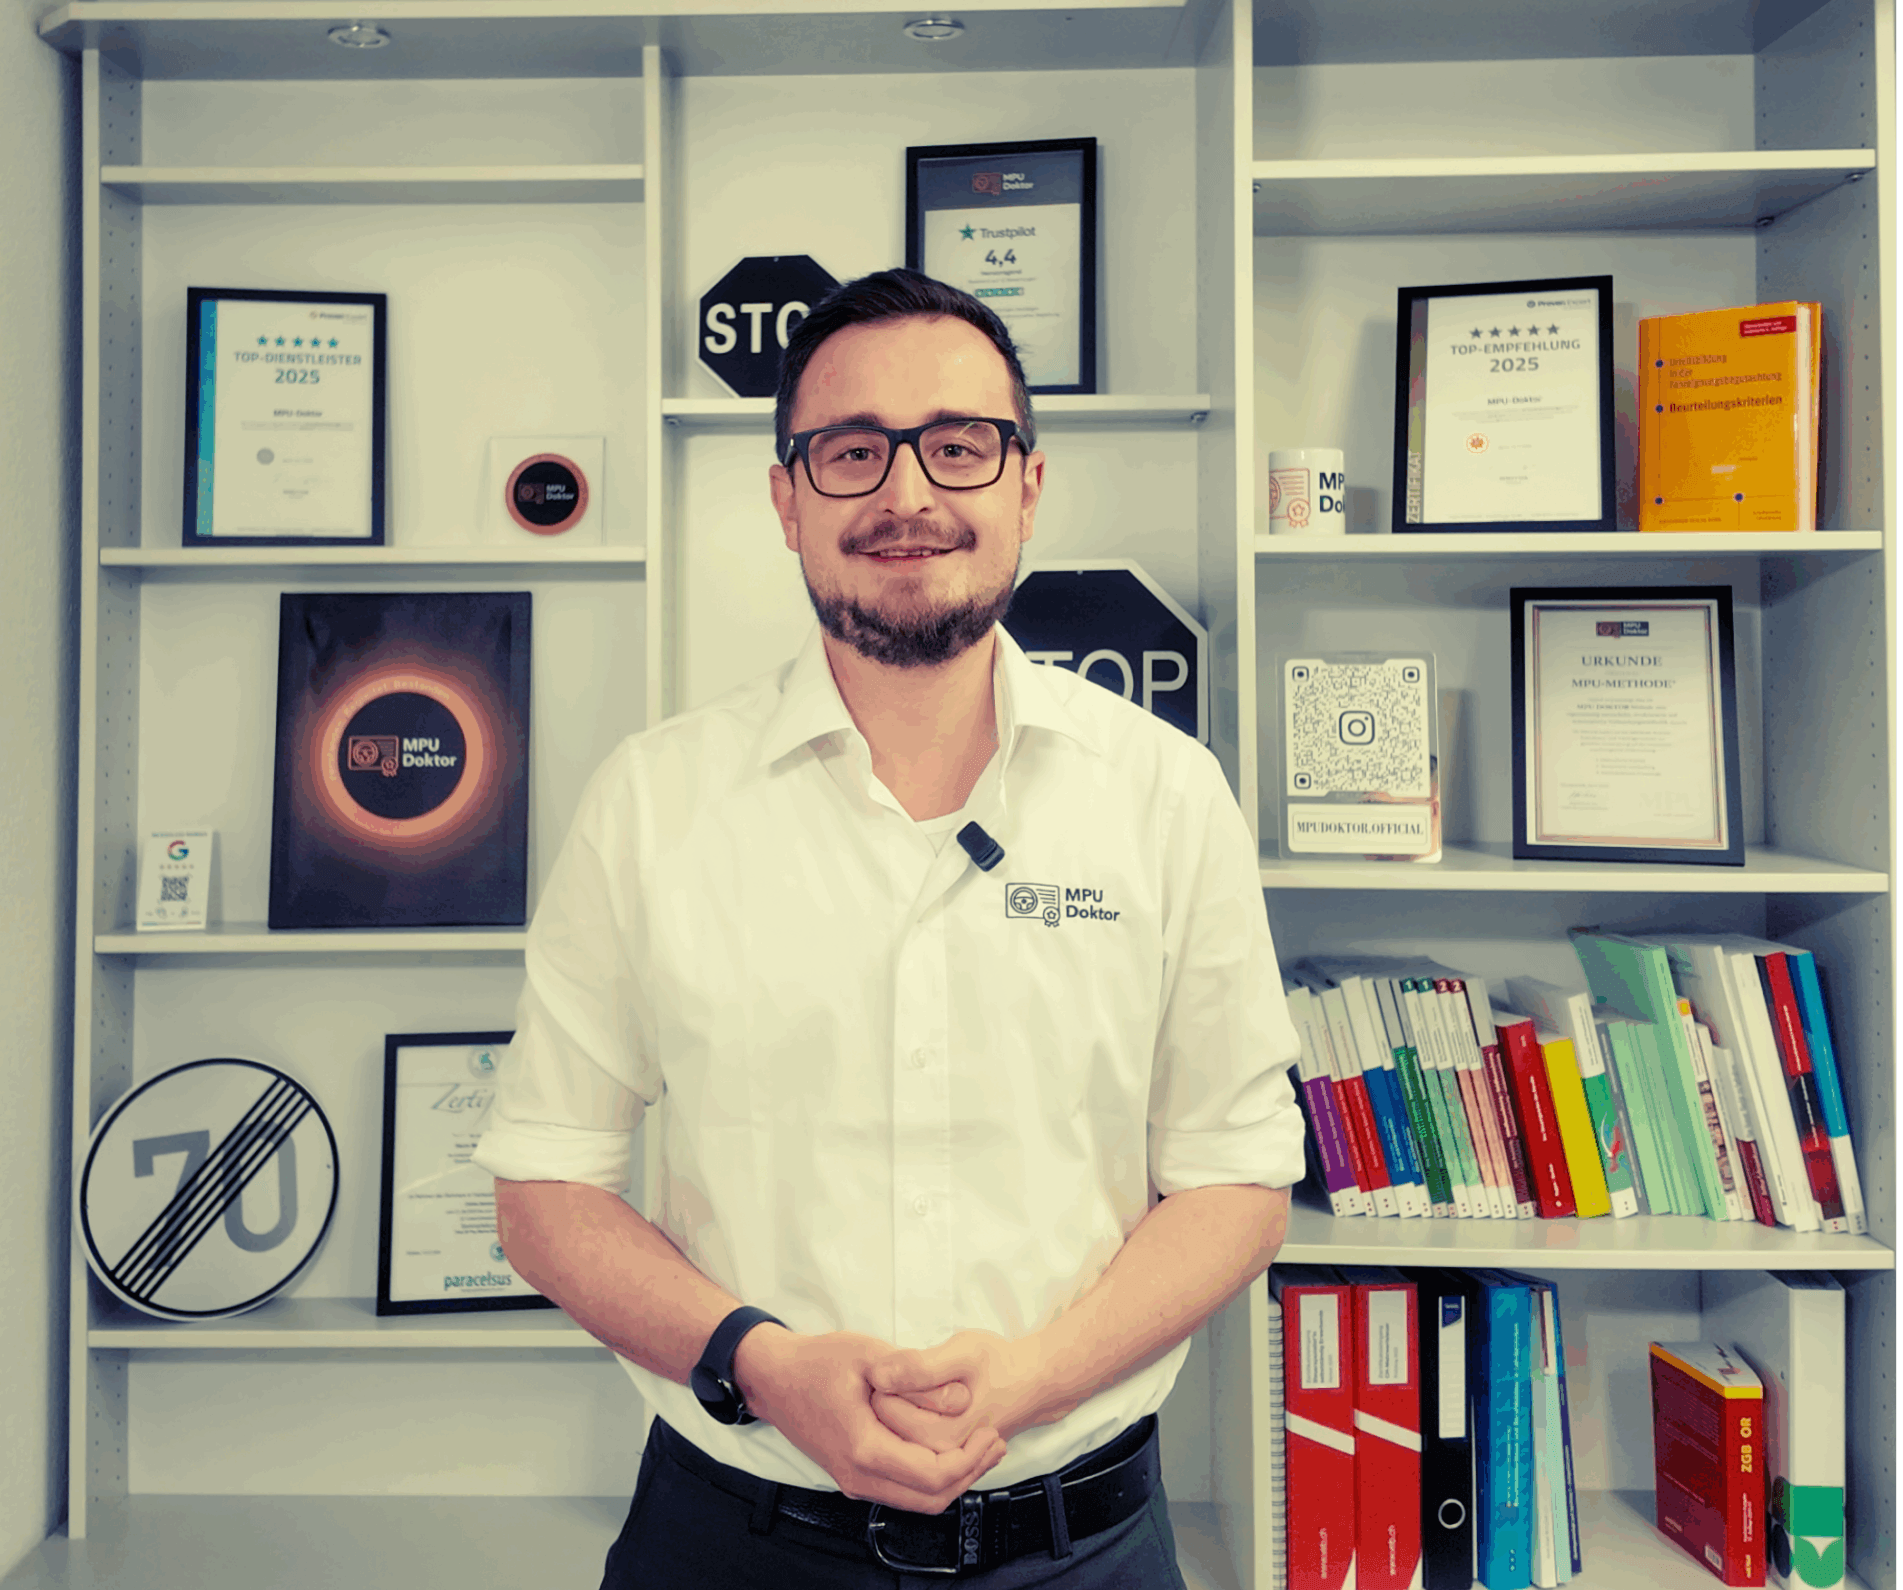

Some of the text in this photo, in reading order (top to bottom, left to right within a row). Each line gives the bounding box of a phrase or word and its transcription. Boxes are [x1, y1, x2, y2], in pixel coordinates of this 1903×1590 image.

[1003, 173, 1025, 181] MPU
[1003, 181, 1034, 190] Doktor
[980, 226, 1036, 240] Trustpilot
[984, 249, 1017, 267] 4,4
[704, 301, 811, 354] STO
[1450, 339, 1581, 355] TOP-EMPFEHLUNG
[234, 351, 362, 365] TOP-DIENSTLEISTER
[1490, 357, 1539, 373] 2025
[275, 369, 320, 384] 2025
[546, 484, 566, 492] MPU
[1319, 472, 1344, 490] MP
[1581, 656, 1663, 667] URKUNDE
[402, 738, 440, 752] MPU
[402, 752, 457, 767] Doktor
[1297, 821, 1424, 835] MPUDOKTOR.OFFICIAL
[1065, 888, 1103, 902] MPU
[1066, 905, 1120, 921] Doktor
[133, 1122, 298, 1262] 70
[444, 1271, 512, 1291] paracelsus
[1740, 1417, 1752, 1473] ZGB OR
[963, 1511, 979, 1565] BOSS
